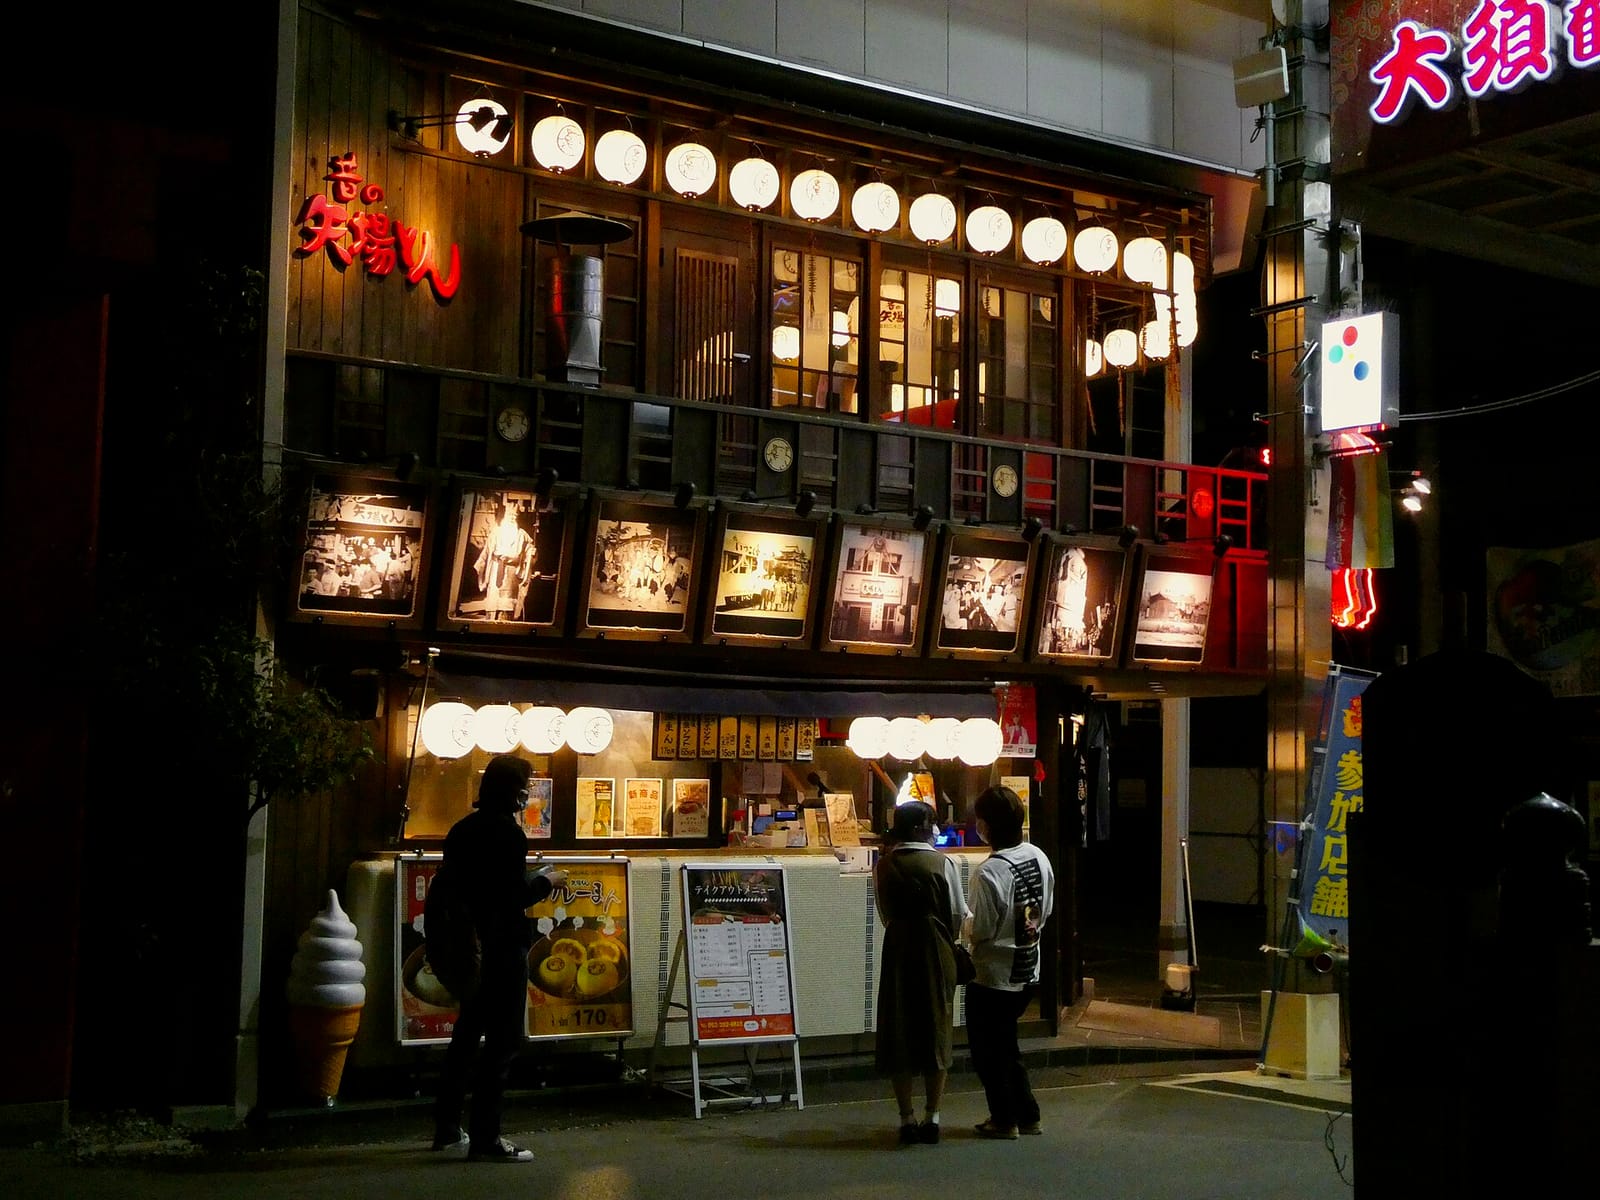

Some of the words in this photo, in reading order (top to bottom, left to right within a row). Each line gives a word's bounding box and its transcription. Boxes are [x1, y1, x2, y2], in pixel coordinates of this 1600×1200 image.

[323, 151, 385, 206] 昔の
[293, 192, 462, 300] 矢場とん
[694, 885, 776, 896] テイクアウトメニュー
[574, 1008, 607, 1028] 170
